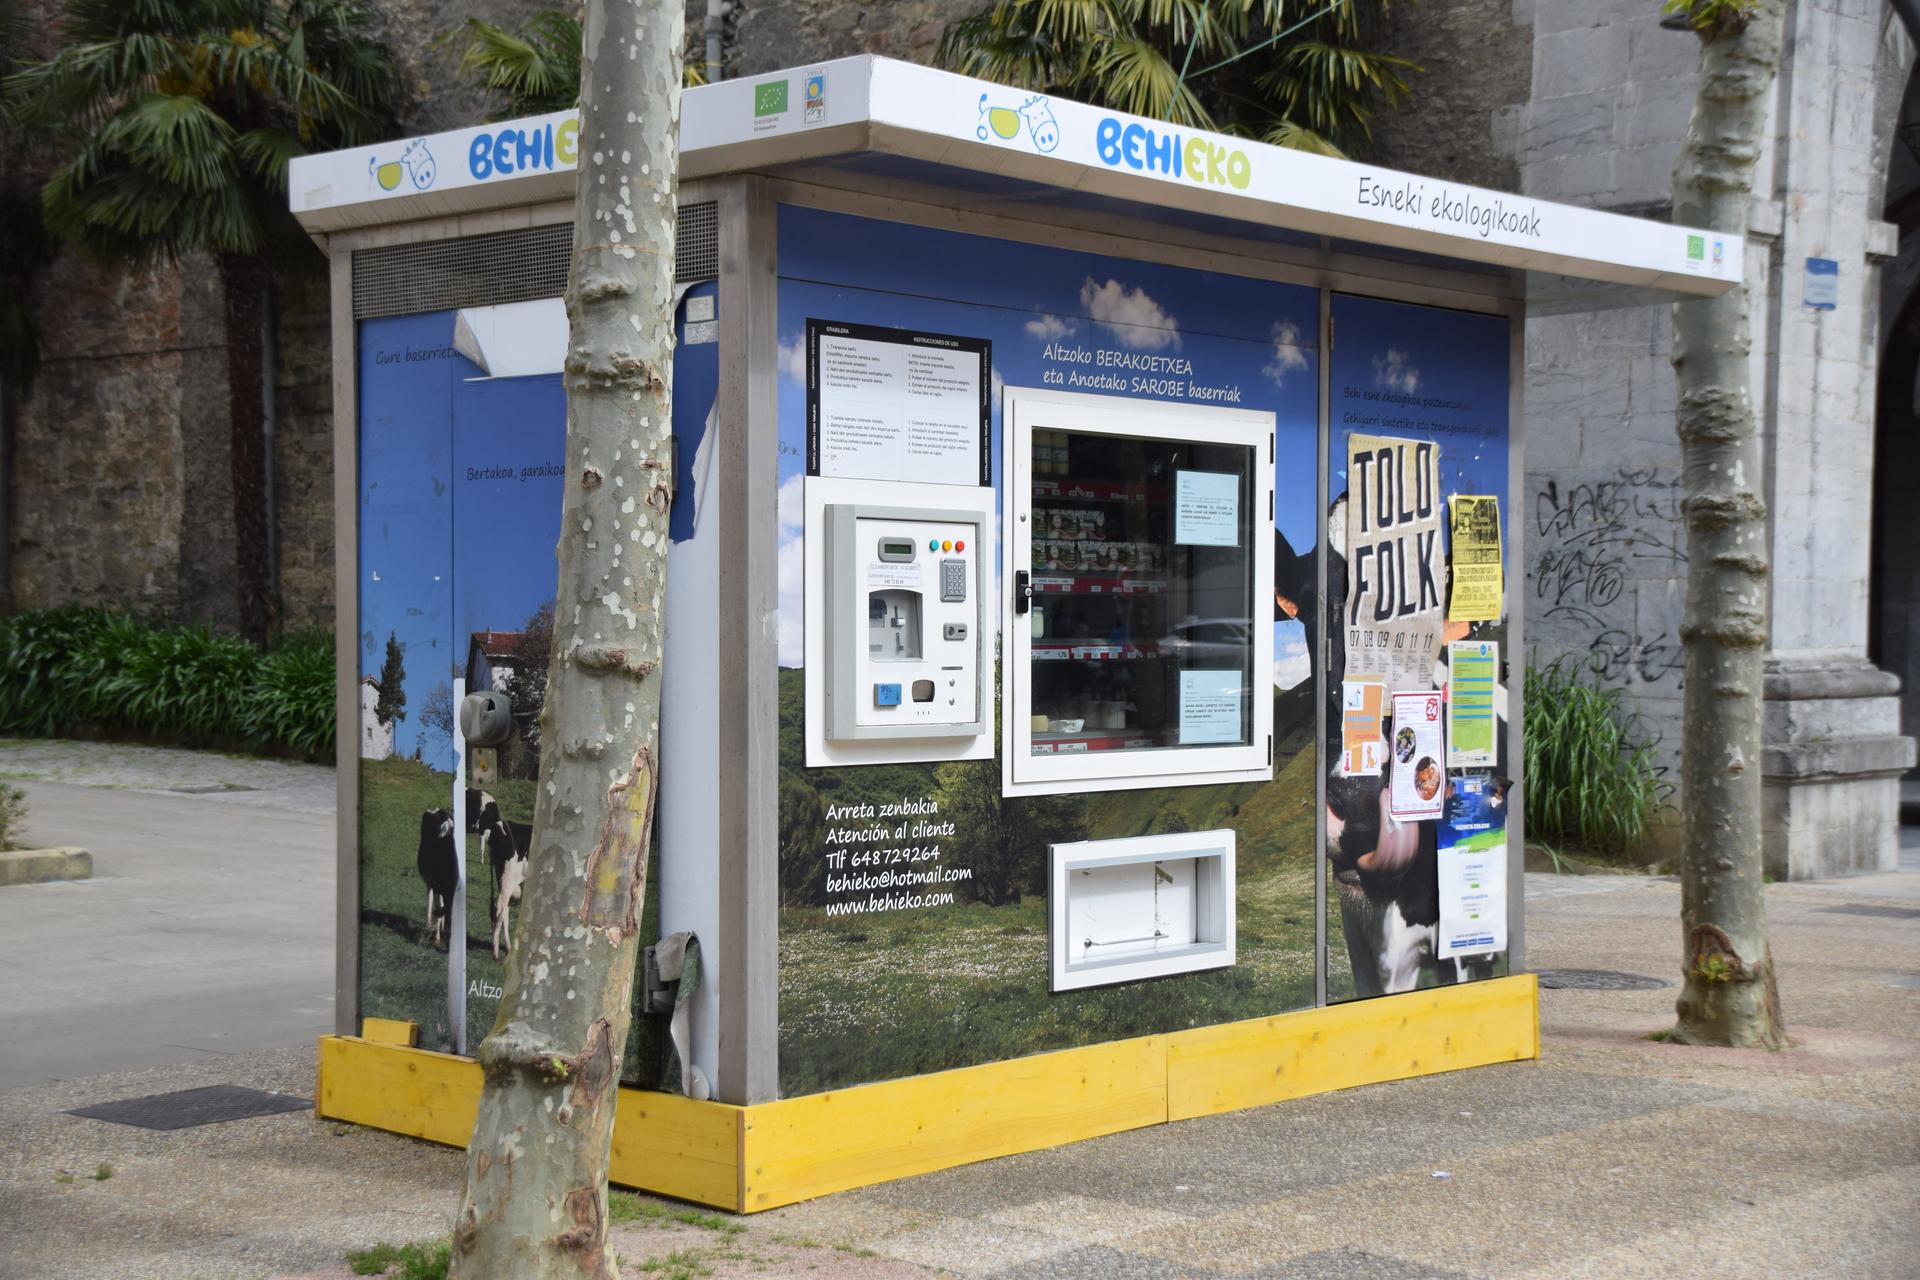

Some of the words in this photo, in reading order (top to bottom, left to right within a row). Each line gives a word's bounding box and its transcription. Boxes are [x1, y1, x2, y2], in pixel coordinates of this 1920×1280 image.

[1096, 118, 1251, 189] BEHIEKO
[1358, 177, 1424, 215] Esneki
[1431, 189, 1541, 238] ekologikoak
[1042, 342, 1092, 364] Altzoko
[1096, 350, 1193, 375] BERAKOETXEA
[1043, 370, 1064, 385] eta
[1068, 370, 1127, 391] Anoetako
[1132, 377, 1184, 397] SAROBE
[1189, 381, 1241, 403] baserriak
[1353, 442, 1432, 533] TOLO
[1350, 530, 1439, 626] FOLK
[1350, 630, 1359, 647] 07
[1364, 631, 1373, 647] 08
[1377, 631, 1389, 647] 09
[1394, 632, 1404, 648] 10
[1410, 633, 1418, 648] 11
[1423, 633, 1433, 649] 11
[1427, 704, 1437, 717] 24
[826, 803, 874, 820] Arreta
[879, 797, 938, 818] zenbakia
[826, 823, 889, 844] Atención
[895, 821, 907, 839] al
[912, 820, 955, 839] cliente
[826, 849, 847, 869] Tlf
[851, 845, 940, 867] 648729264
[827, 865, 972, 893] behieko@hotmail.com
[826, 890, 954, 917] www.behieko.com
[468, 979, 502, 999] Altzo
